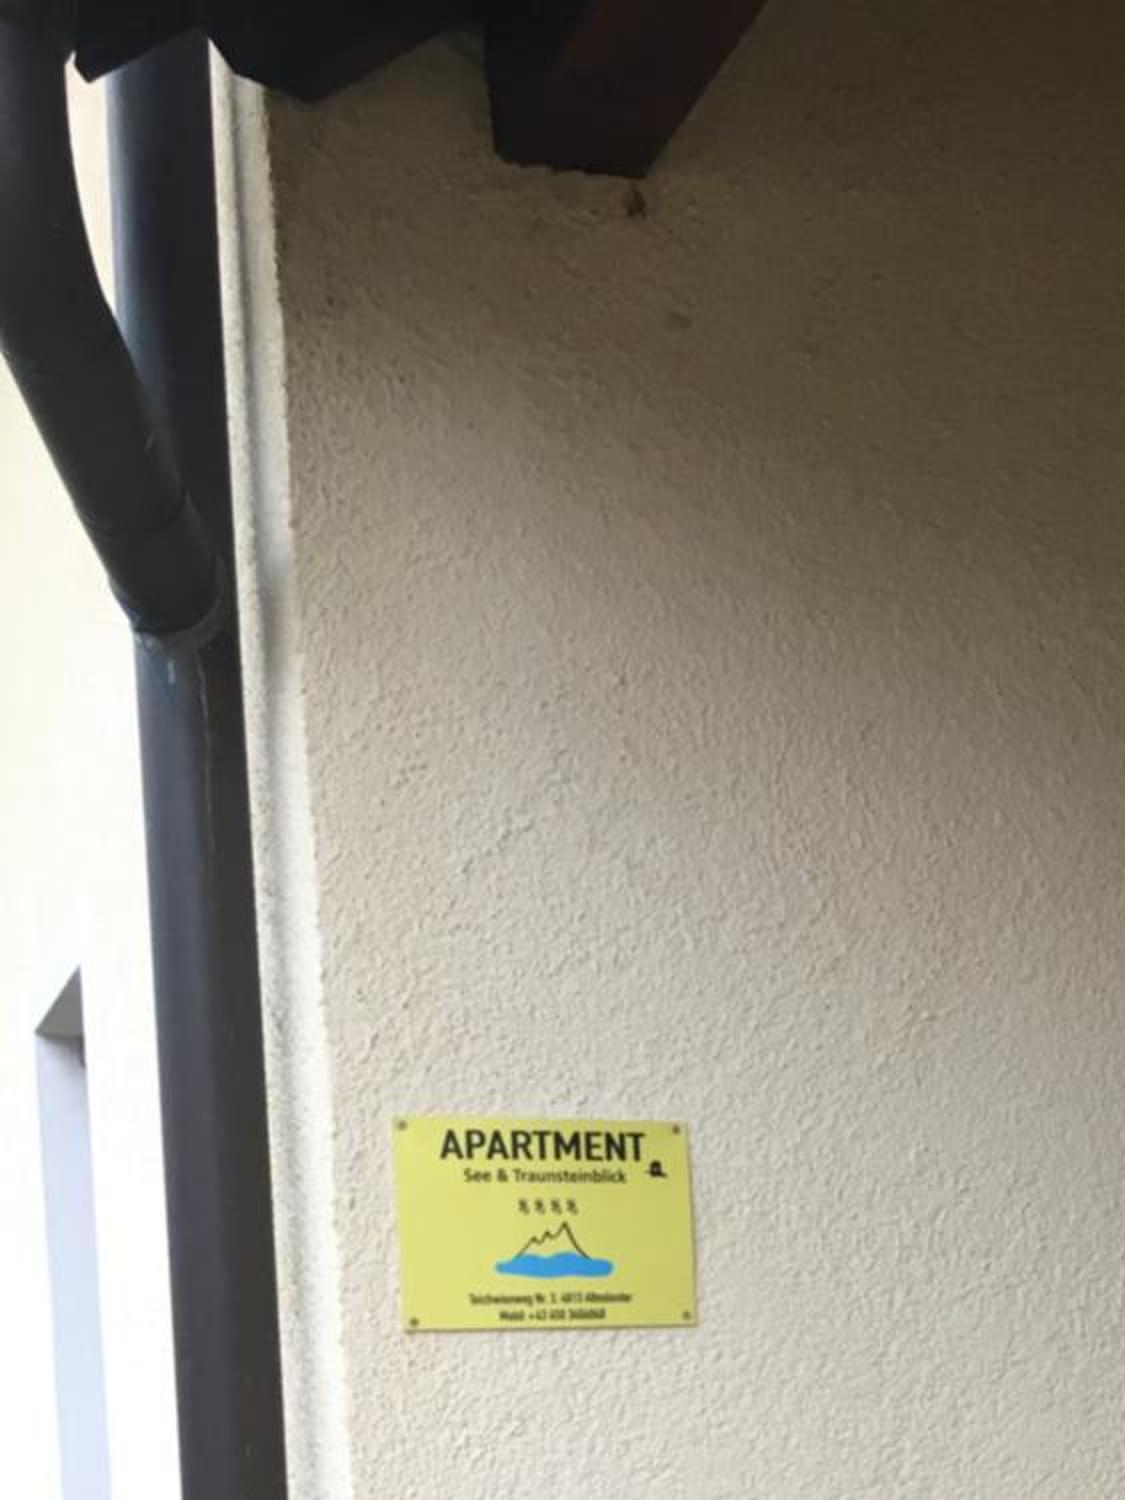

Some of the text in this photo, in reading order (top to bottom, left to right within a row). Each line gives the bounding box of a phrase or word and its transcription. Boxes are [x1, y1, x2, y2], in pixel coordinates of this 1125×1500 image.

[439, 1129, 646, 1162] APARTMENT
[464, 1167, 627, 1184] See & Traunsteinblick
